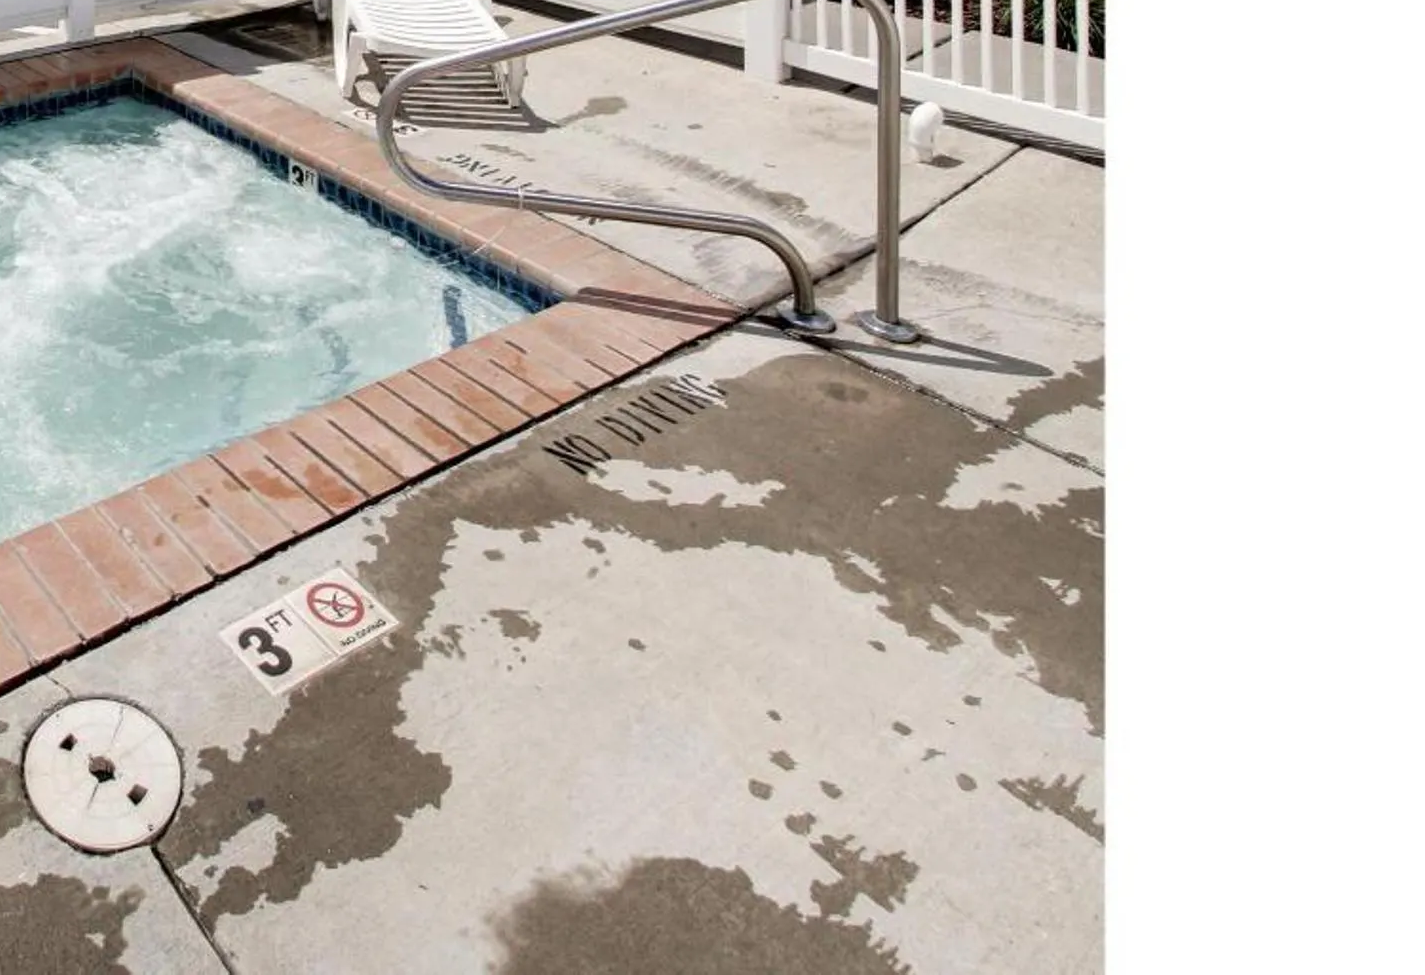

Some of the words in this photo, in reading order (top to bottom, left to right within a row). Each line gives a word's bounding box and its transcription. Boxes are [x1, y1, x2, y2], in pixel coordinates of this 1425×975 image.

[542, 434, 612, 475] NO
[596, 374, 728, 446] DIVING
[265, 609, 293, 633] FT
[238, 627, 293, 678] 3
